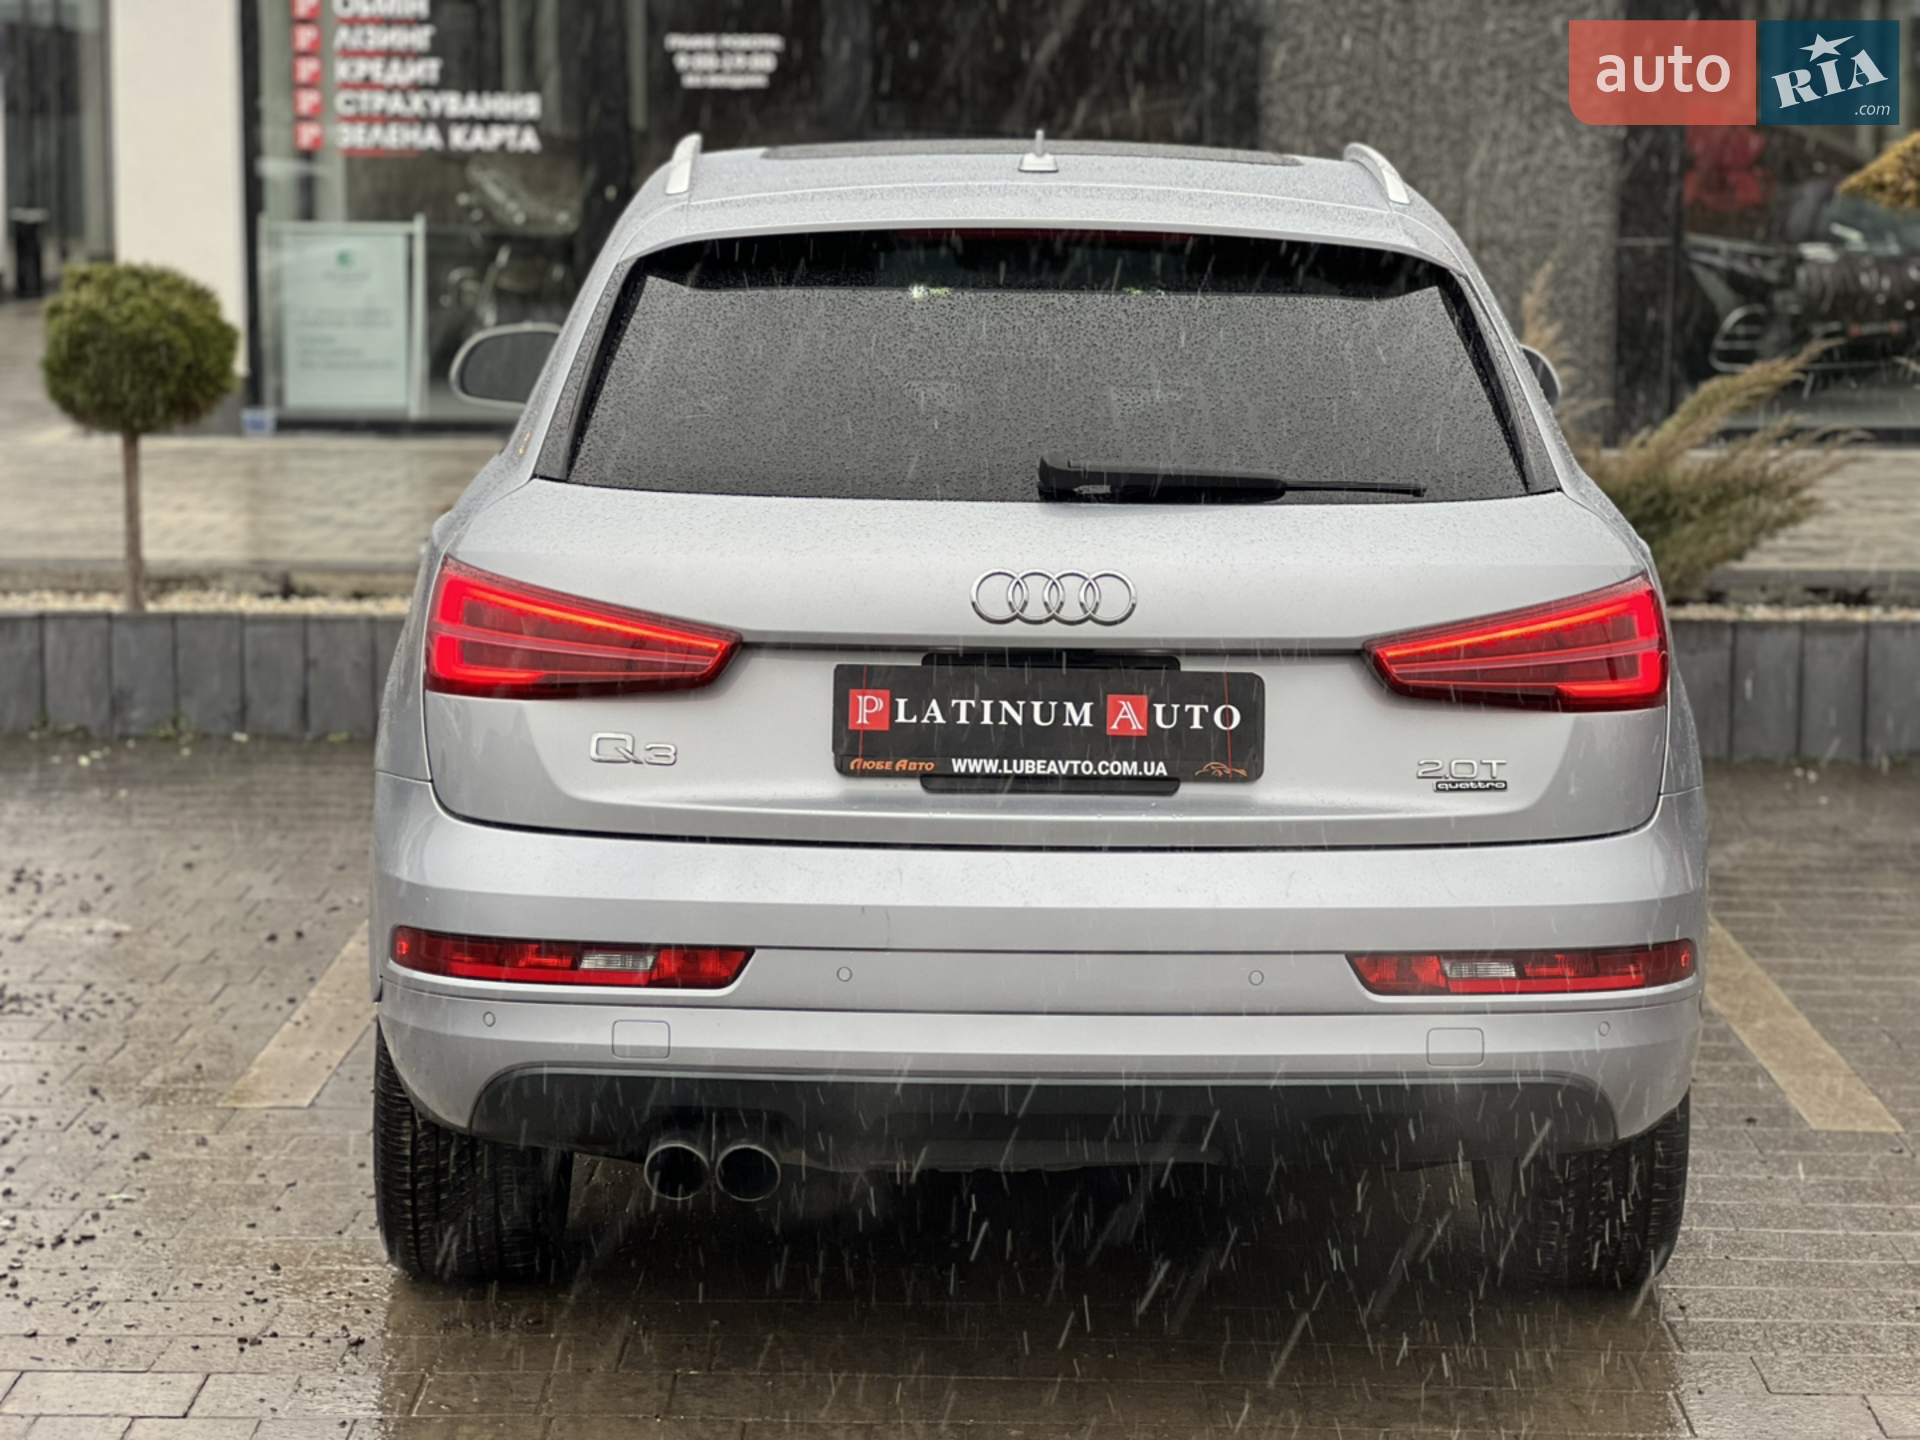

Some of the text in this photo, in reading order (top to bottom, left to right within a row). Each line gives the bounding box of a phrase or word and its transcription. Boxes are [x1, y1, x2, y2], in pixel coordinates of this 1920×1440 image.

[333, 25, 435, 51] ЛІЗИНГ
[334, 57, 442, 84] КРЕДИТ
[334, 91, 542, 119] СТРАХУВАННЯ
[338, 123, 541, 152] ЗЕЛЕНА КАРТА
[855, 695, 1242, 731] PLATINUM AUTO
[590, 731, 678, 766] Q3
[951, 757, 1168, 777] WWW.LUBEAVTO.COM.UA
[1416, 758, 1507, 779] 2.0T
[1436, 781, 1506, 791] quattro
